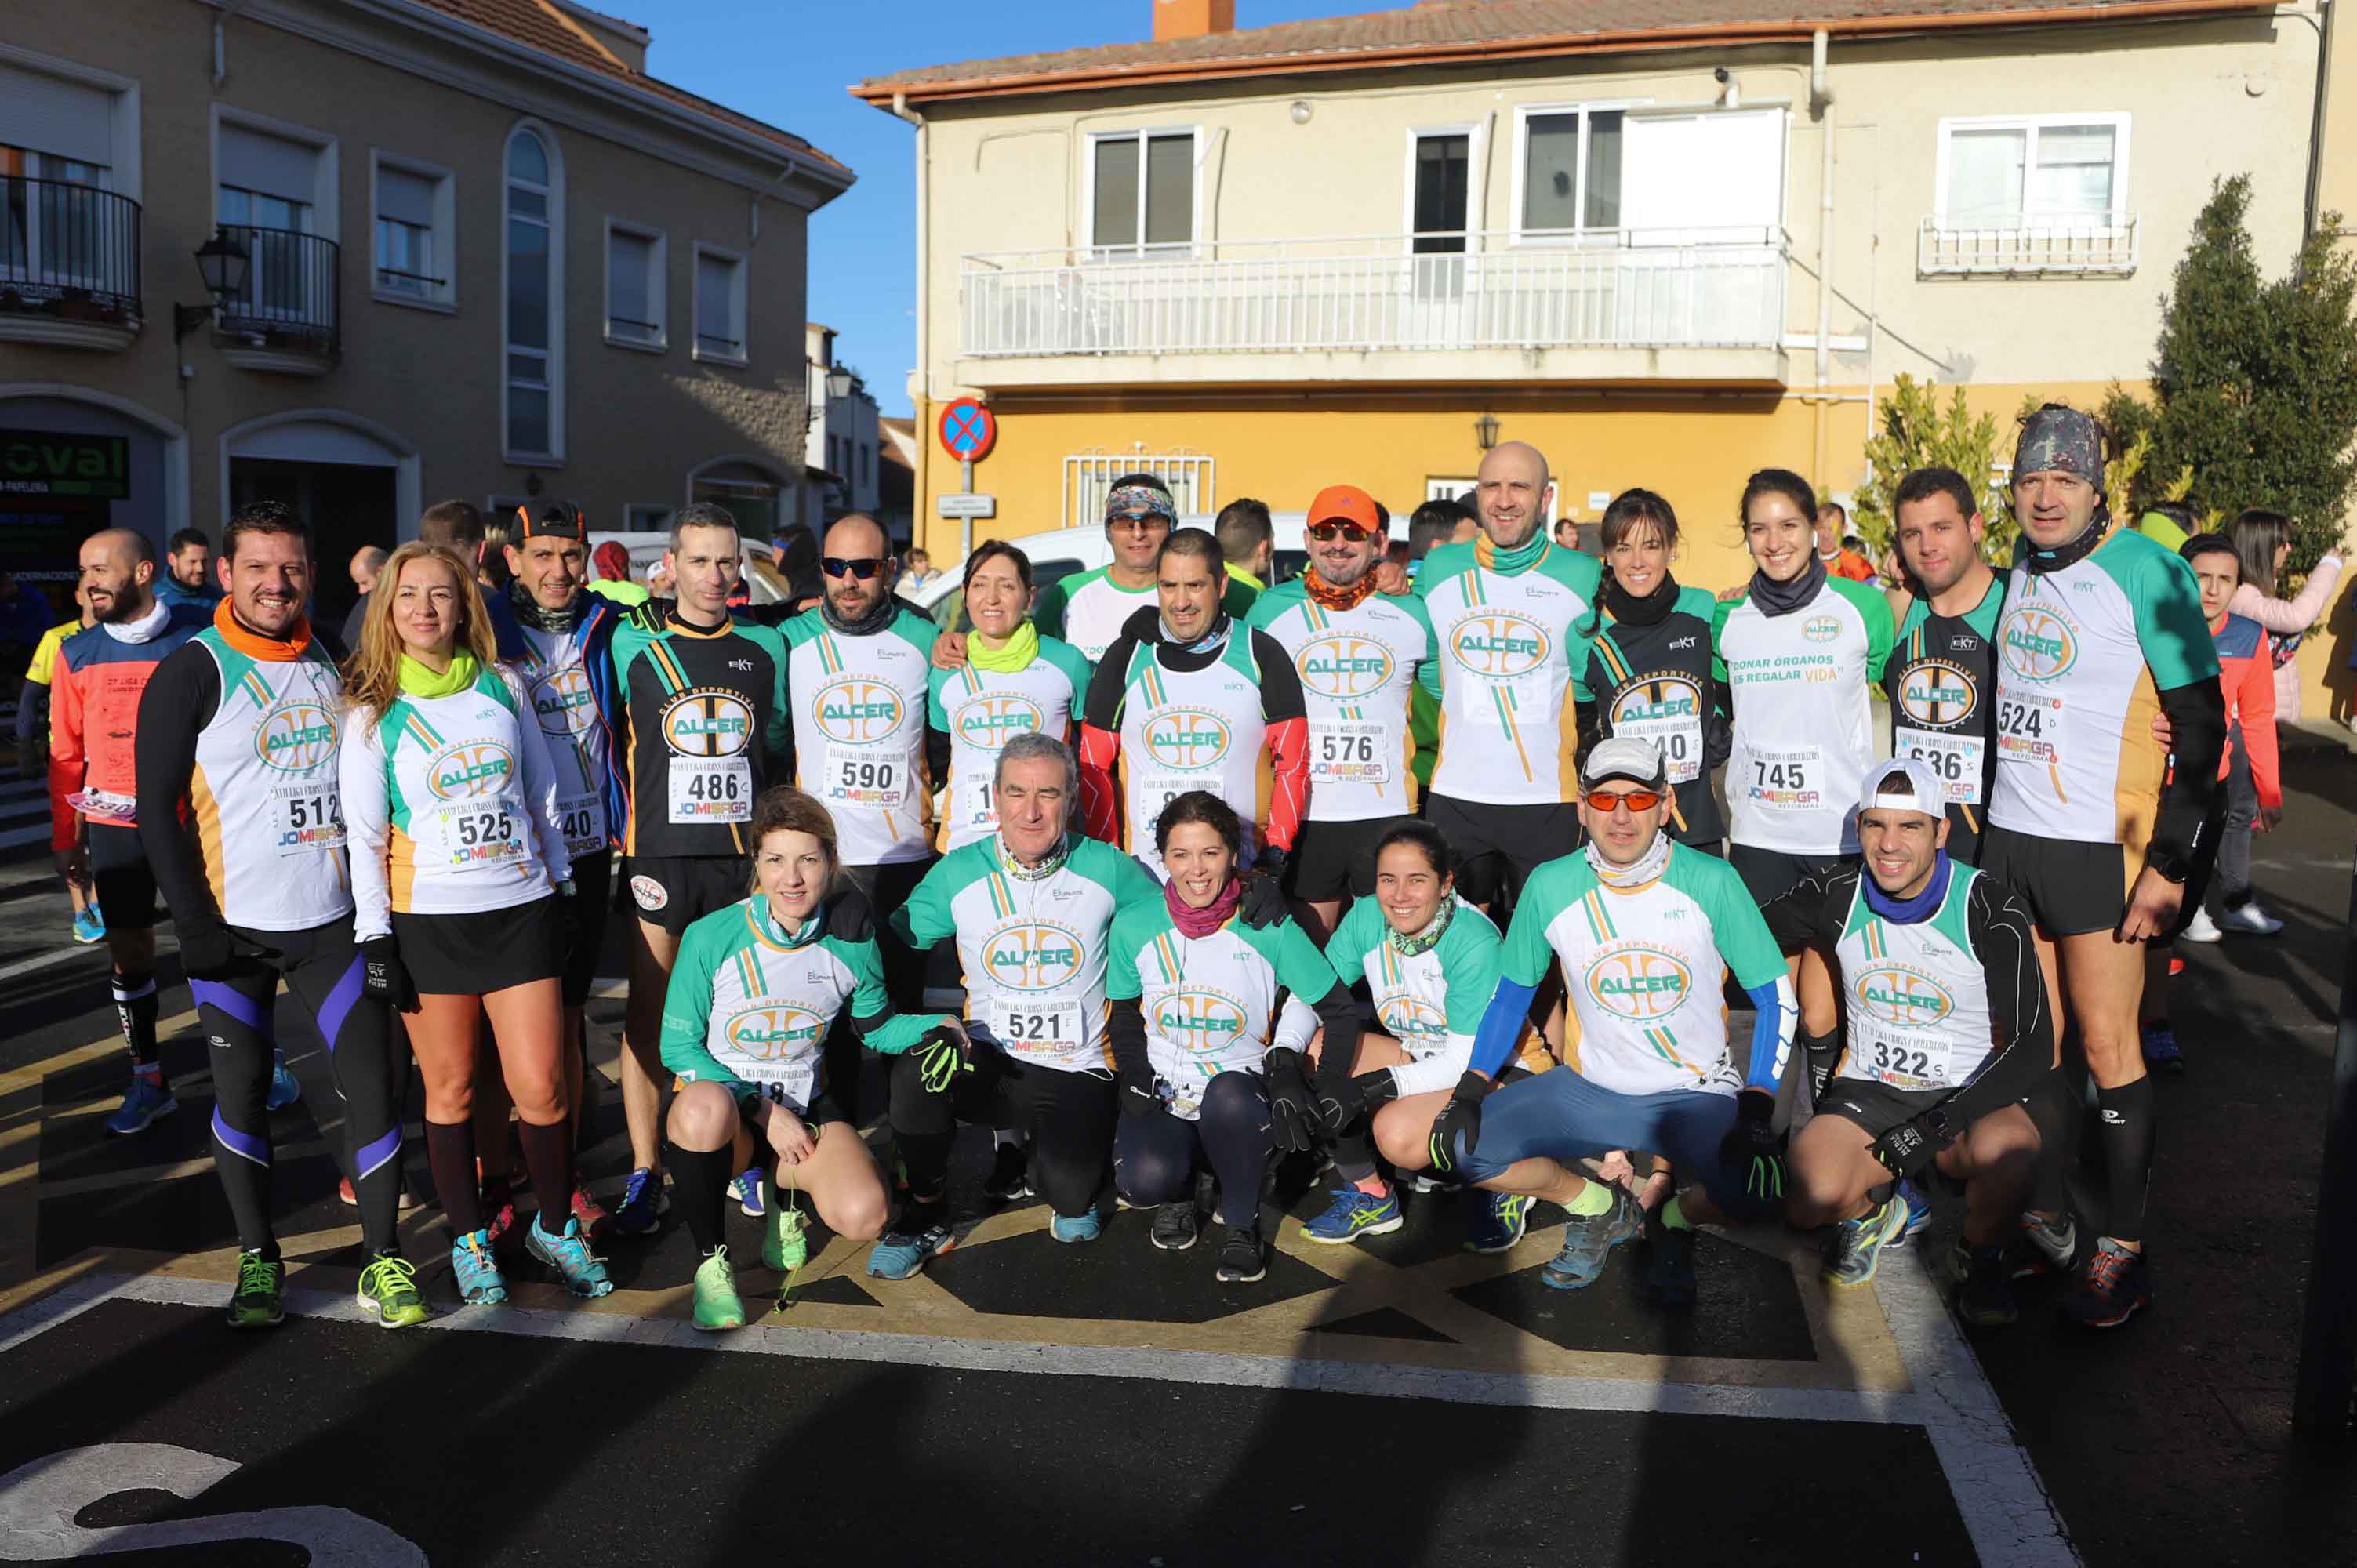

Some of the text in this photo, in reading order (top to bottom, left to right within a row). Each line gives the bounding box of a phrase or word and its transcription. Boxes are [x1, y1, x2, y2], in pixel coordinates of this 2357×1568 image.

[1459, 636, 1539, 657] ALCER
[2006, 629, 2063, 662] ALCER
[1305, 658, 1385, 676] ALCER
[1774, 655, 1834, 666] ÓRGANOS
[1924, 658, 1977, 681] DEPORTIVO
[1635, 670, 1704, 687] DEPORTIVO
[1734, 676, 1745, 684] ES
[1747, 670, 1801, 683] REGALAR
[538, 688, 592, 715] ALCE
[659, 686, 755, 715] CLUB DEPORTIVO
[1906, 686, 1967, 706] ALCER
[821, 703, 895, 720] ALCER
[1622, 697, 1694, 721] ALCER
[1999, 702, 2041, 738] 524
[674, 717, 745, 735] ALCER
[962, 713, 1033, 731] ALCER
[266, 724, 334, 750] ALCER
[1152, 731, 1222, 749] ALCER
[1323, 736, 1373, 761] 576
[439, 758, 509, 788] ALCER
[841, 761, 892, 789] 590
[1755, 760, 1804, 789] 745
[688, 774, 738, 800] 486
[290, 795, 340, 829] 512
[458, 811, 512, 845] 525
[991, 949, 1075, 967] ALCER
[1599, 975, 1682, 994] ALCER
[1865, 987, 1944, 1011] ALCER
[1009, 1014, 1059, 1039] 521
[1160, 1014, 1238, 1033] ALCER
[1875, 1042, 1928, 1078] 322
